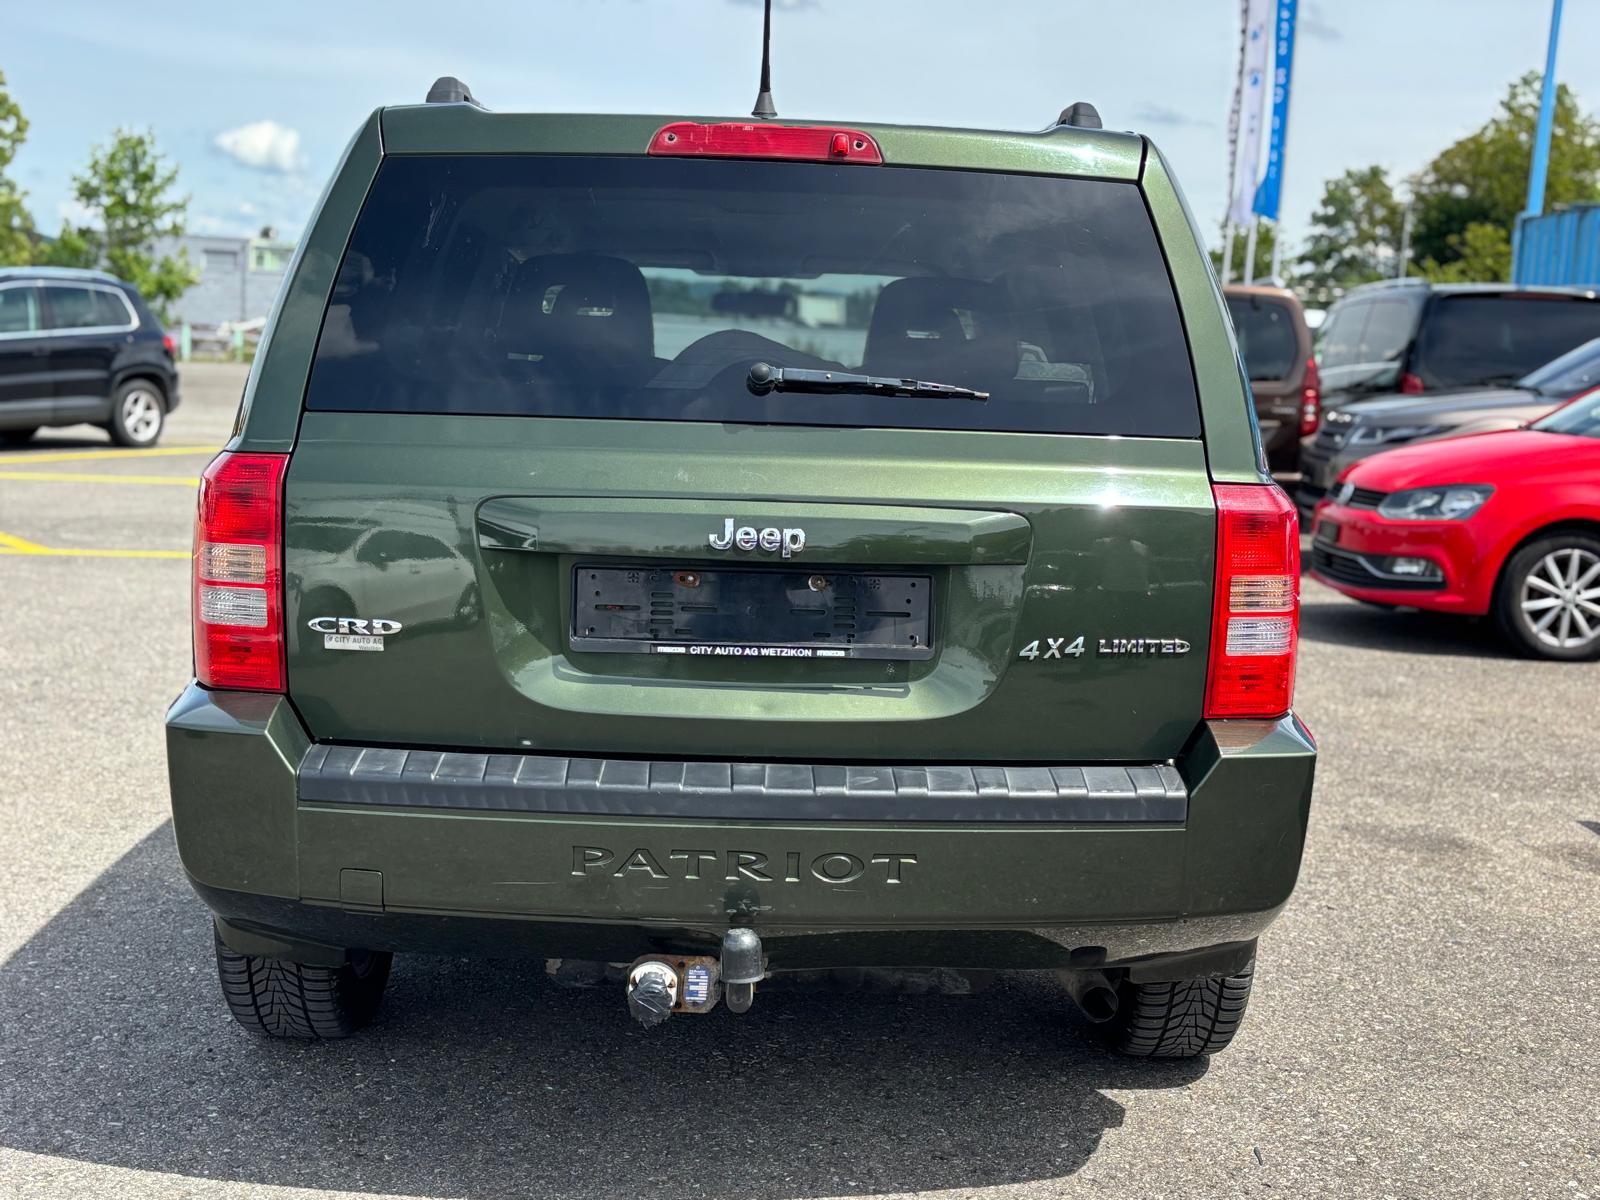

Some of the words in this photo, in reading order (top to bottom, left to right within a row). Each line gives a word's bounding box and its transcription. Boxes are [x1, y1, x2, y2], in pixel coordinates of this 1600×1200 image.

[708, 518, 806, 558] Jeep
[307, 616, 403, 635] CRD
[690, 646, 713, 654] CITY
[714, 647, 742, 655] AUTO
[743, 648, 758, 656] AG
[760, 648, 812, 657] WETZIKON
[1018, 636, 1085, 660] 4X4
[1098, 638, 1191, 654] LIMITED
[571, 845, 918, 885] PATRIOT
